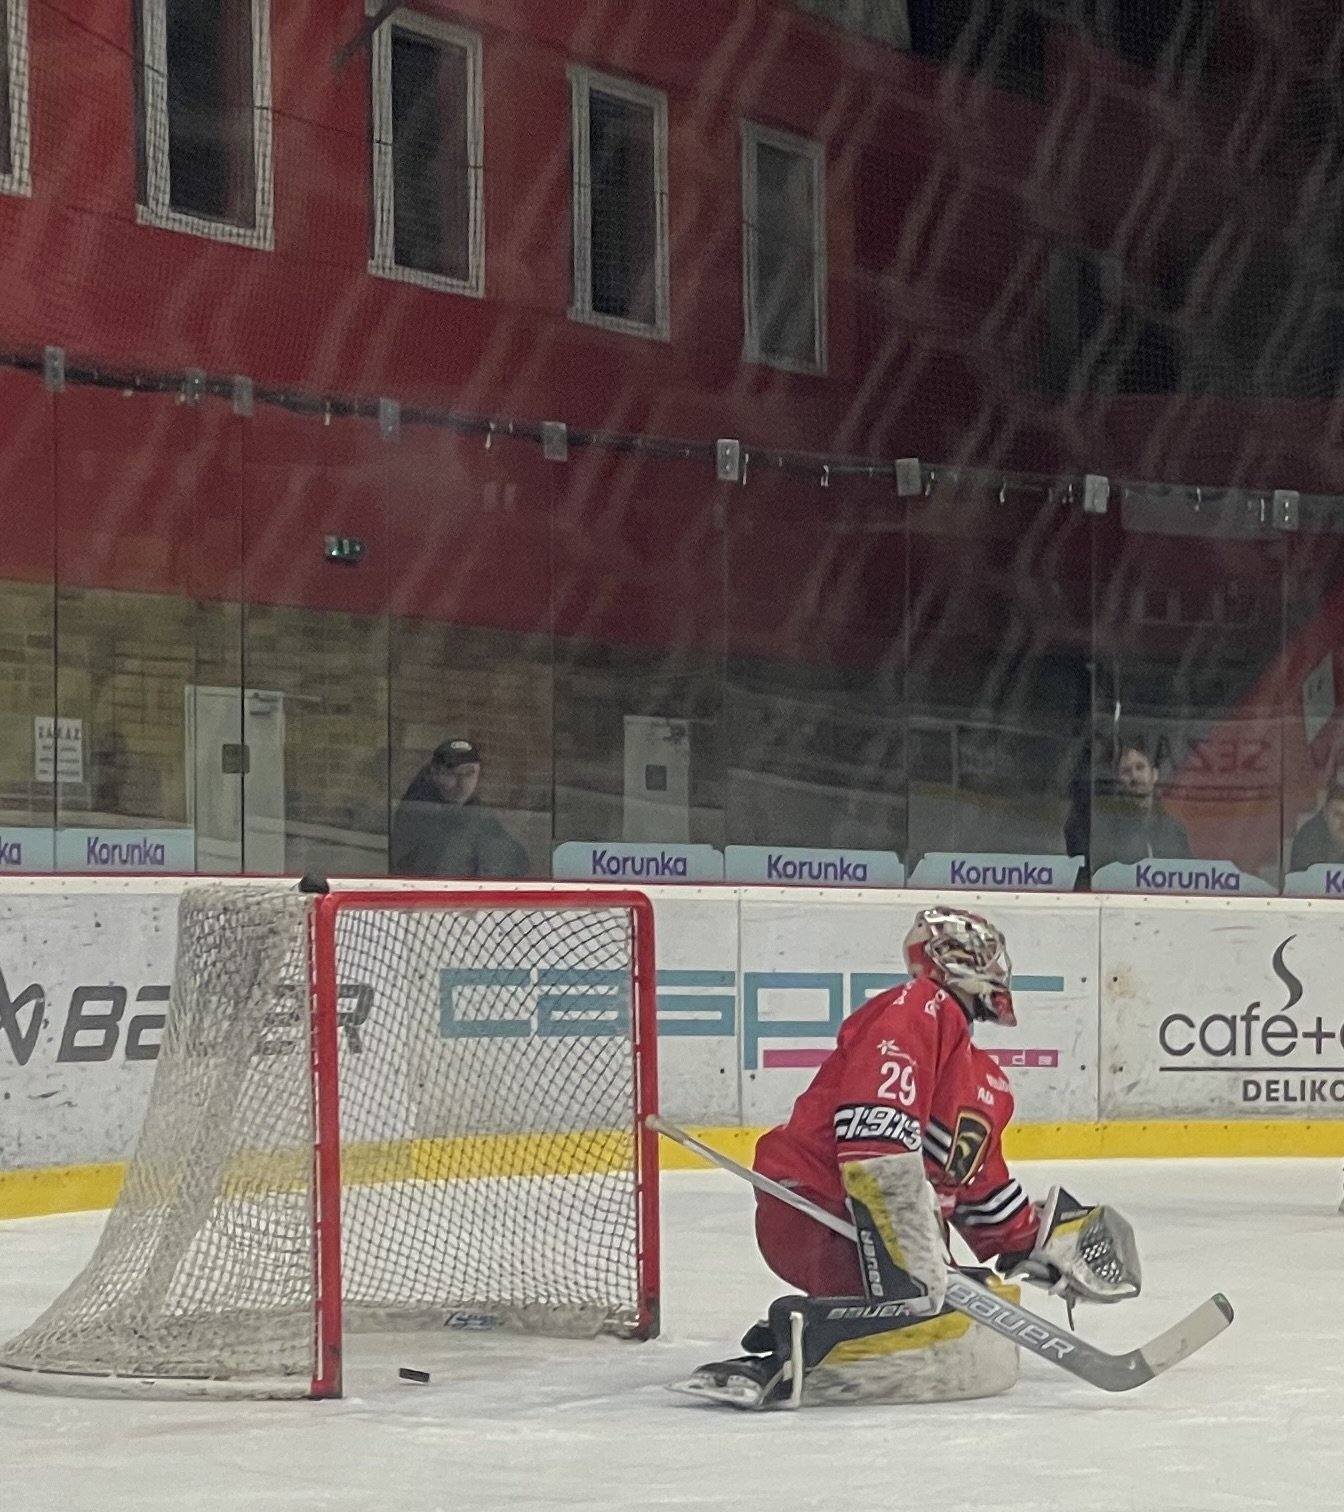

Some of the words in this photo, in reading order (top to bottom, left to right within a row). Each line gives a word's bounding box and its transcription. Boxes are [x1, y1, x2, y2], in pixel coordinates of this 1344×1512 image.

[86, 836, 165, 866] Korunka
[591, 849, 688, 877] Korunka
[766, 853, 868, 883] Korunka
[949, 859, 1054, 886] Korunka
[1135, 864, 1240, 891] Korunka
[877, 1061, 917, 1107] 29
[950, 1282, 1077, 1360] BAUER
